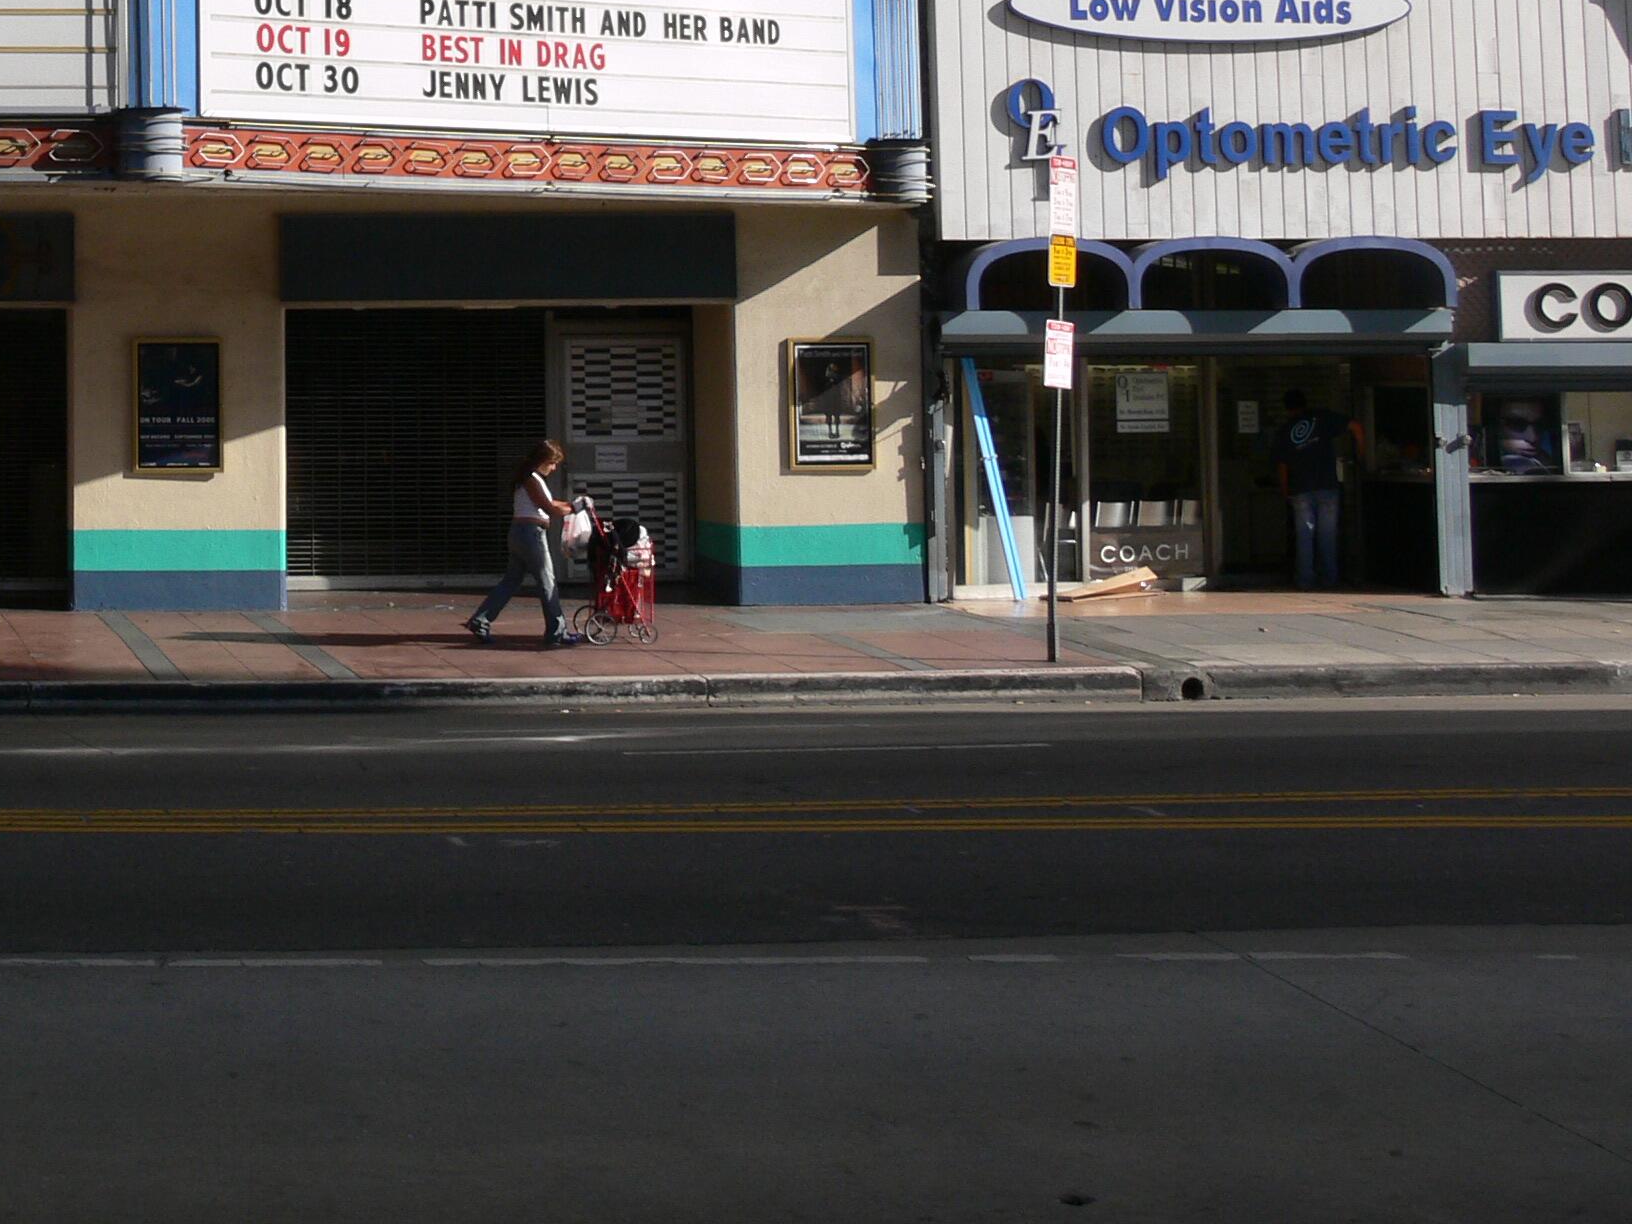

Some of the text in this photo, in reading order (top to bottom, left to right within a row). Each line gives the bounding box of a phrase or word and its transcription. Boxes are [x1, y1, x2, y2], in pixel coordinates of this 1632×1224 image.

[509, 3, 585, 34] SMITH
[600, 9, 646, 37] AND
[664, 13, 708, 41] HER
[719, 17, 780, 45] BAND
[256, 23, 606, 71] OCT 19 BEST IN DRAG
[256, 62, 598, 106] OCT 30 JENNY LEWIS
[1103, 105, 1457, 179] Optometric
[1481, 109, 1595, 184] Eye
[1534, 282, 1632, 328] CO
[1100, 543, 1188, 563] COACH
